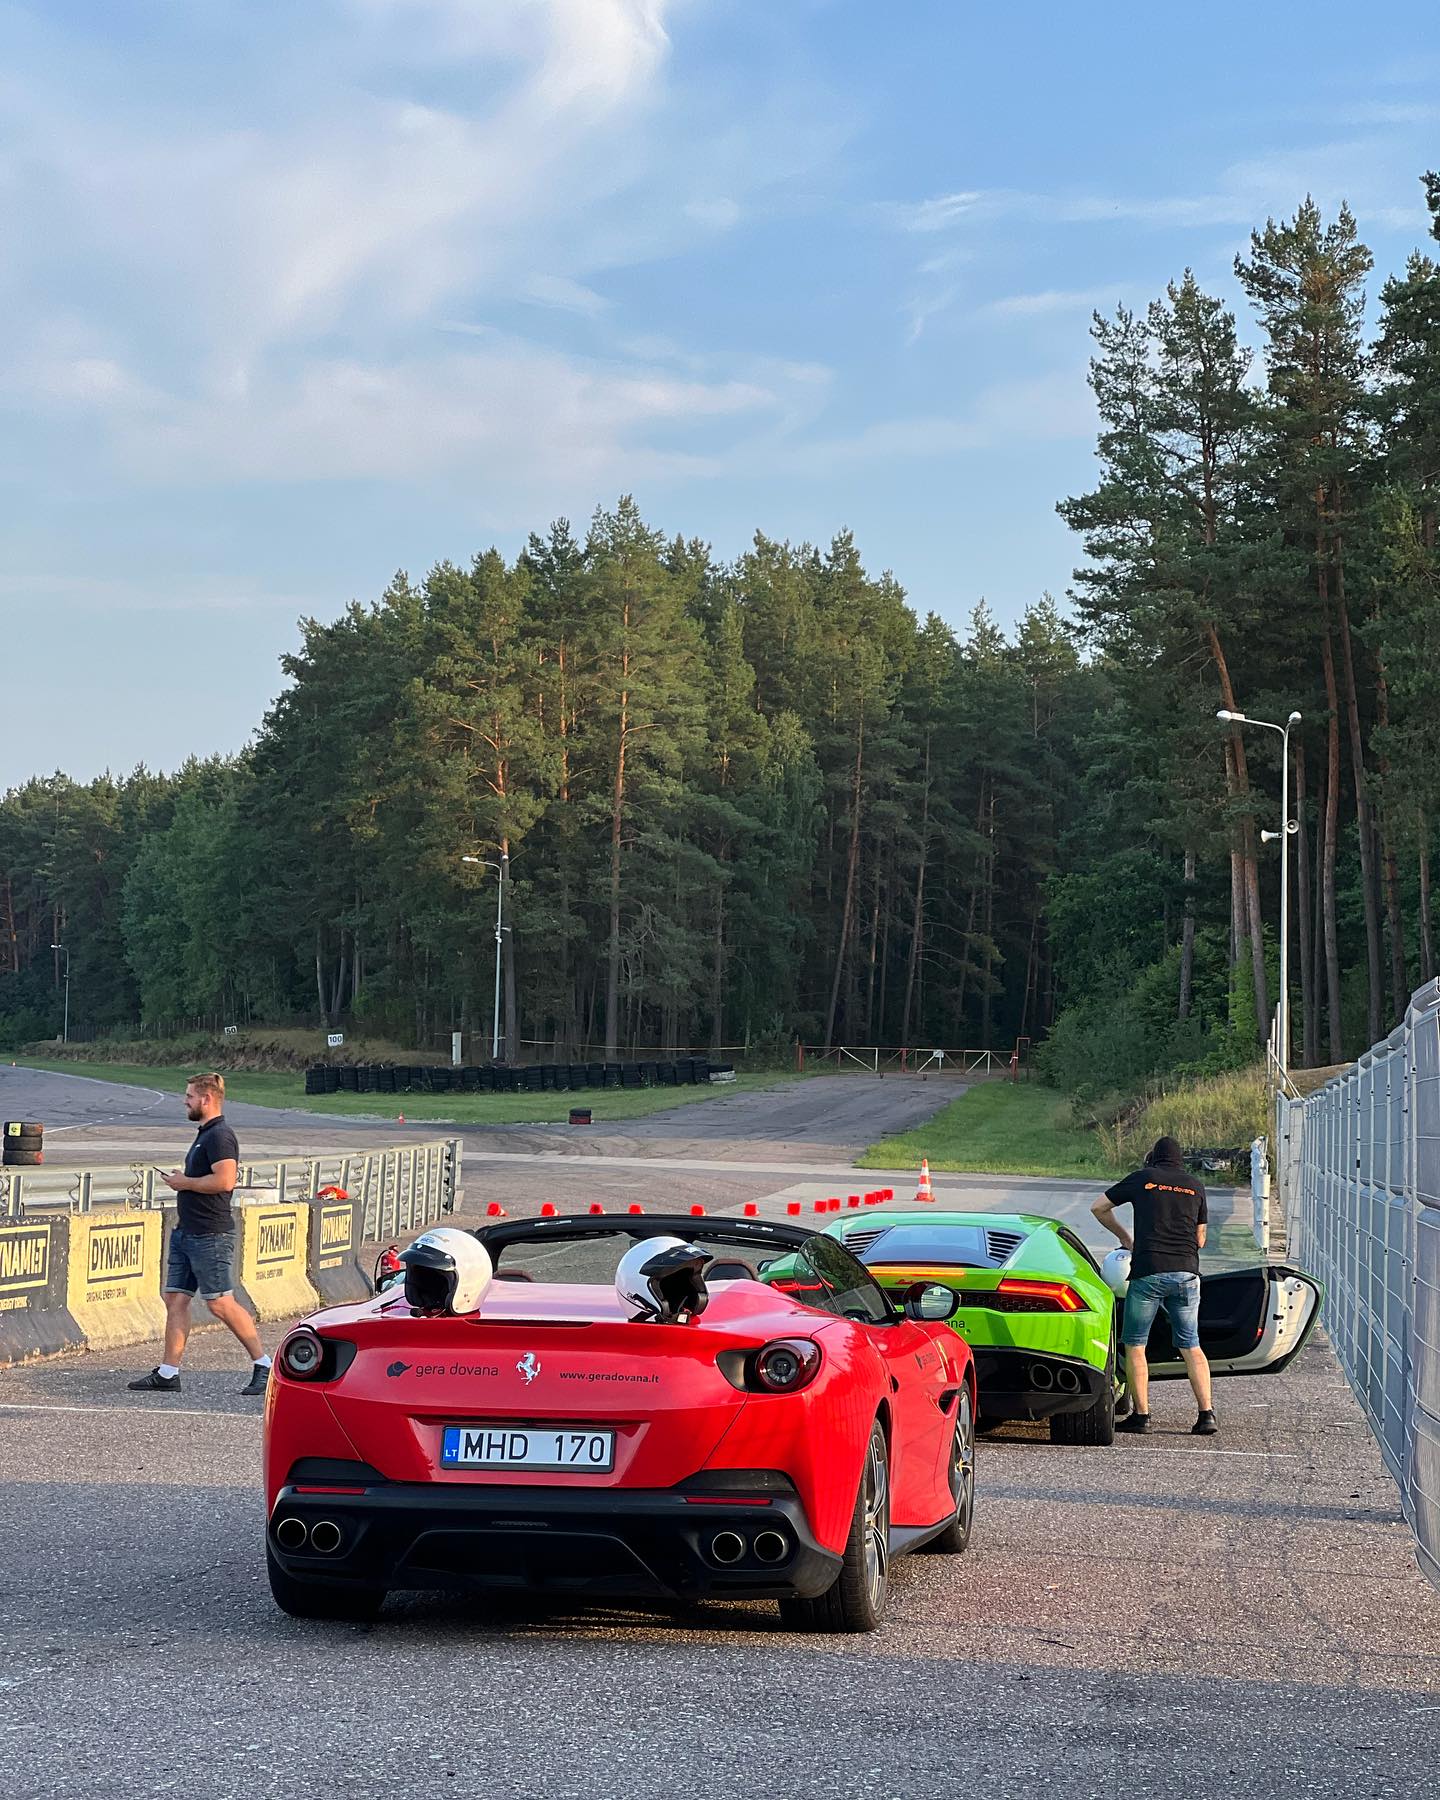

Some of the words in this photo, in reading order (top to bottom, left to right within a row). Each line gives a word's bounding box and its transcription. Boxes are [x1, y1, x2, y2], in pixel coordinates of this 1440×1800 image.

[226, 1027, 236, 1035] 50
[329, 1035, 342, 1043] 100
[944, 1320, 965, 1329] ana
[415, 1365, 445, 1378] gera
[449, 1362, 499, 1376] dovana
[560, 1372, 660, 1384] www.geradovana.lt
[445, 1449, 458, 1457] LT
[463, 1432, 529, 1460] MHD
[555, 1434, 605, 1463] 170
